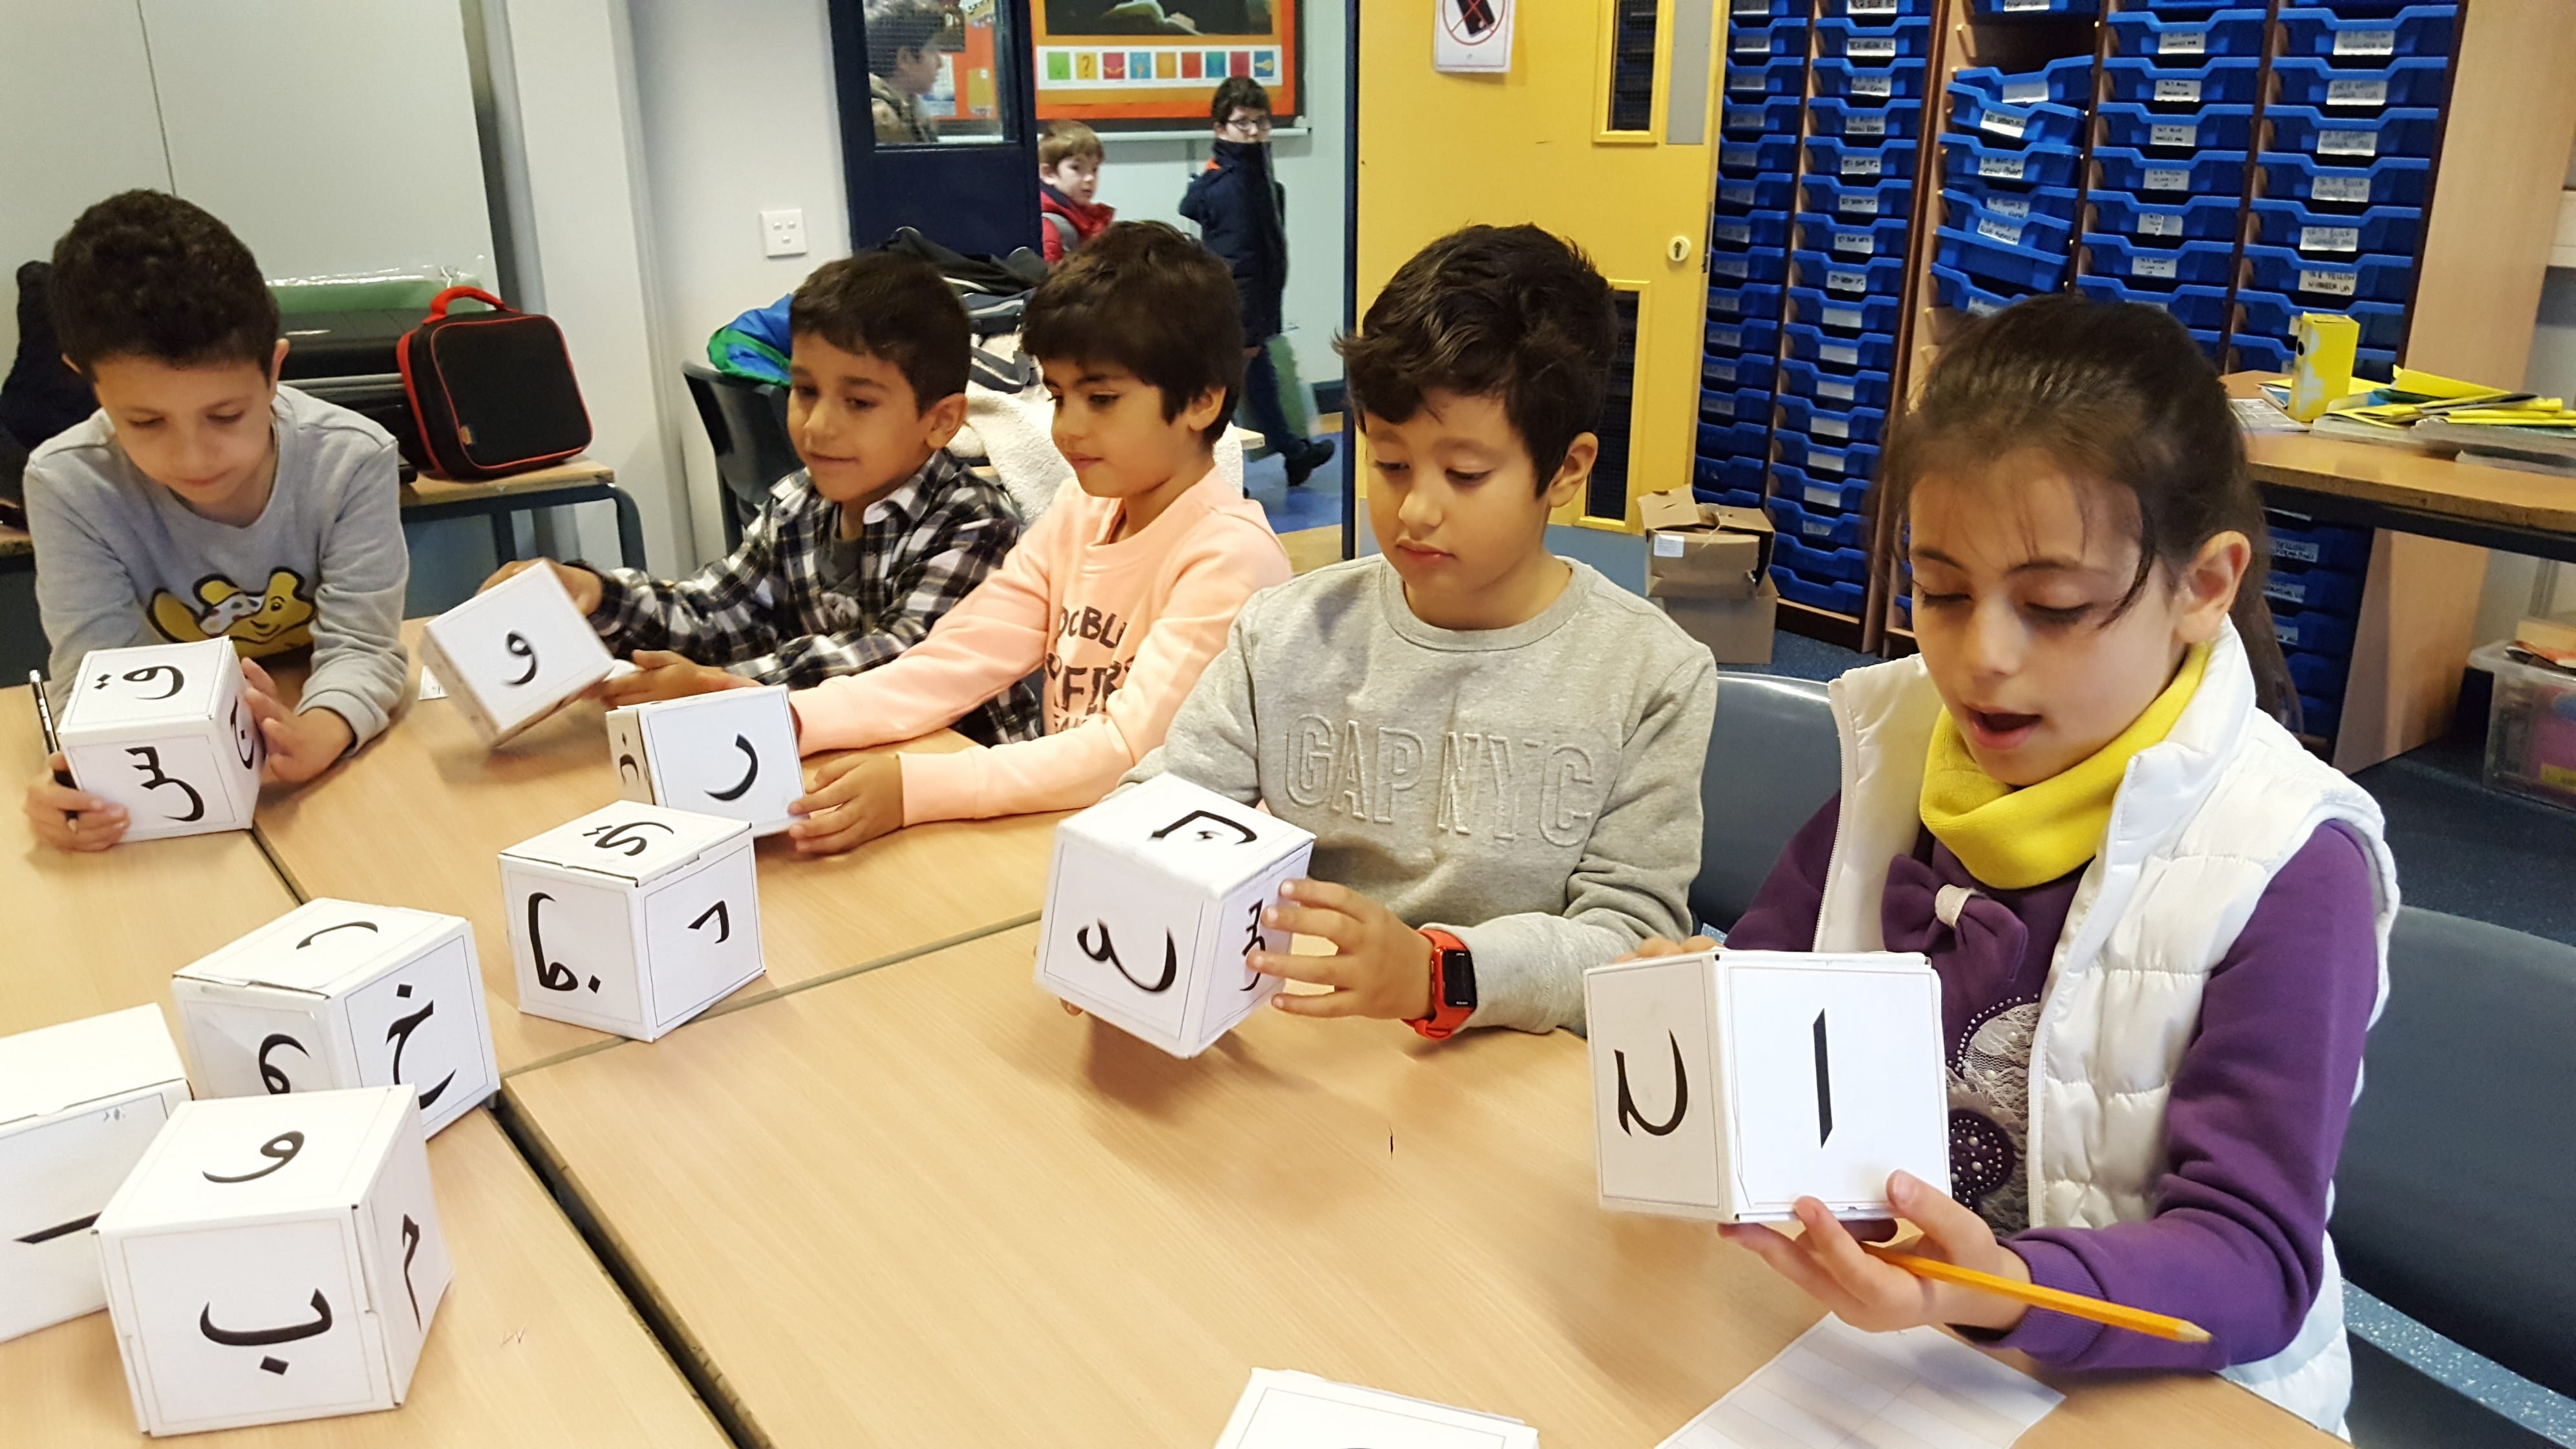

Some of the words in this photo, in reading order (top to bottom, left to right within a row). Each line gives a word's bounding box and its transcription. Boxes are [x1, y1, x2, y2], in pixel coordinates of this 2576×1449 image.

[502, 631, 539, 687] و
[124, 746, 206, 822] س
[703, 733, 759, 802] ر
[1285, 713, 1425, 823] GAP
[1437, 731, 1594, 847] NYC
[385, 983, 457, 1111] خ
[1812, 1007, 1834, 1150] ا
[202, 1130, 305, 1184] و
[199, 1288, 333, 1376] ب
